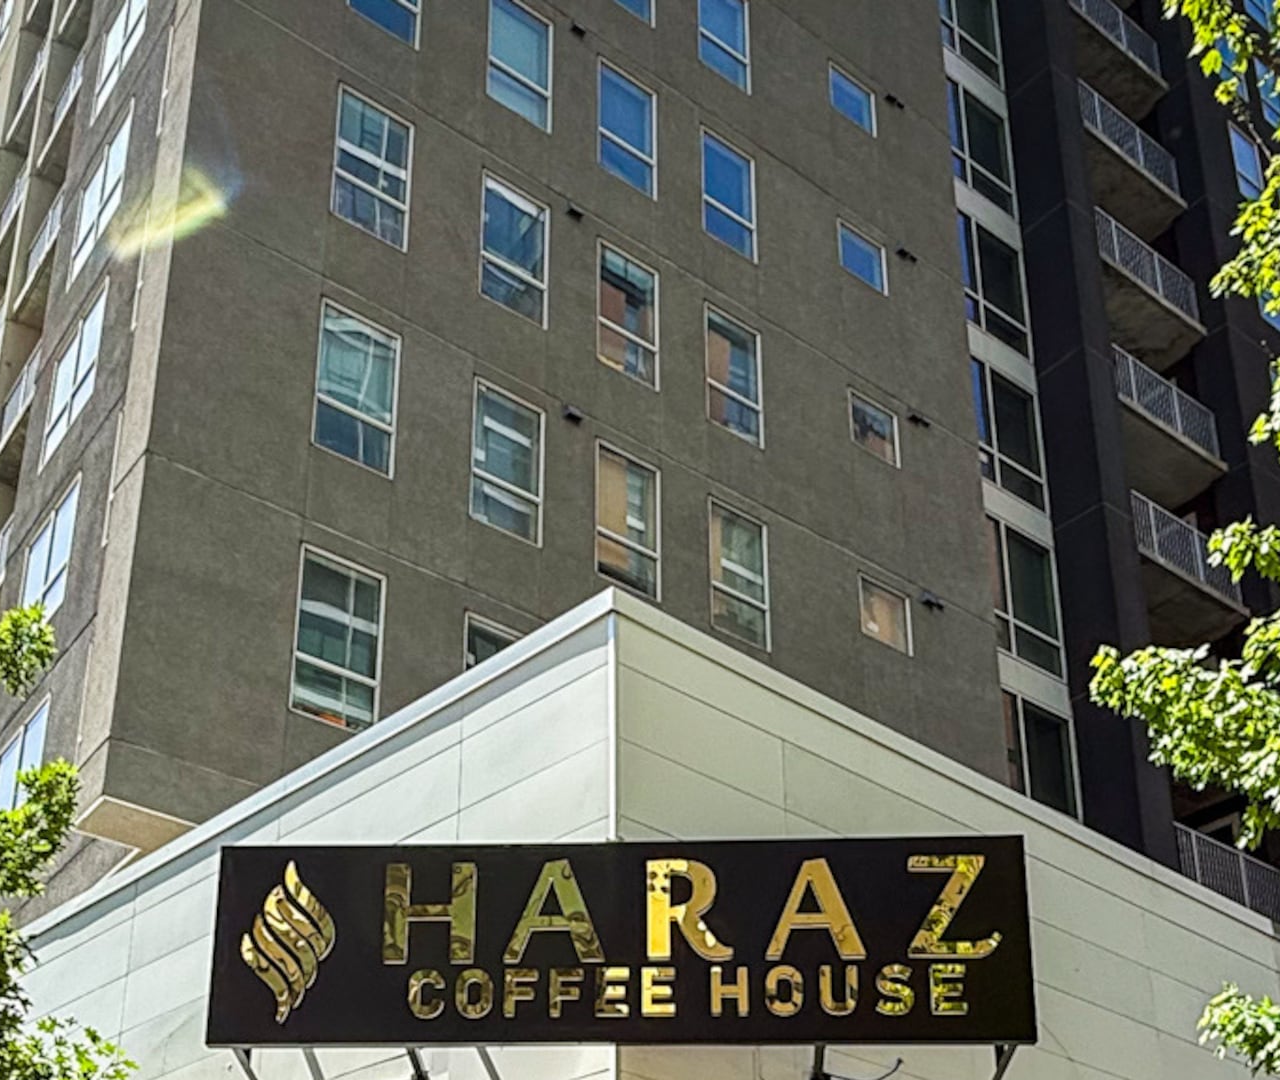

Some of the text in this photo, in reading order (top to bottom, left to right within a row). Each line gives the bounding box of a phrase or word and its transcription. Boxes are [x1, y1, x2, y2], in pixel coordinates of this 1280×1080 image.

[383, 855, 1002, 964] HARAZ
[407, 963, 969, 1019] COFFEE HOUSE
